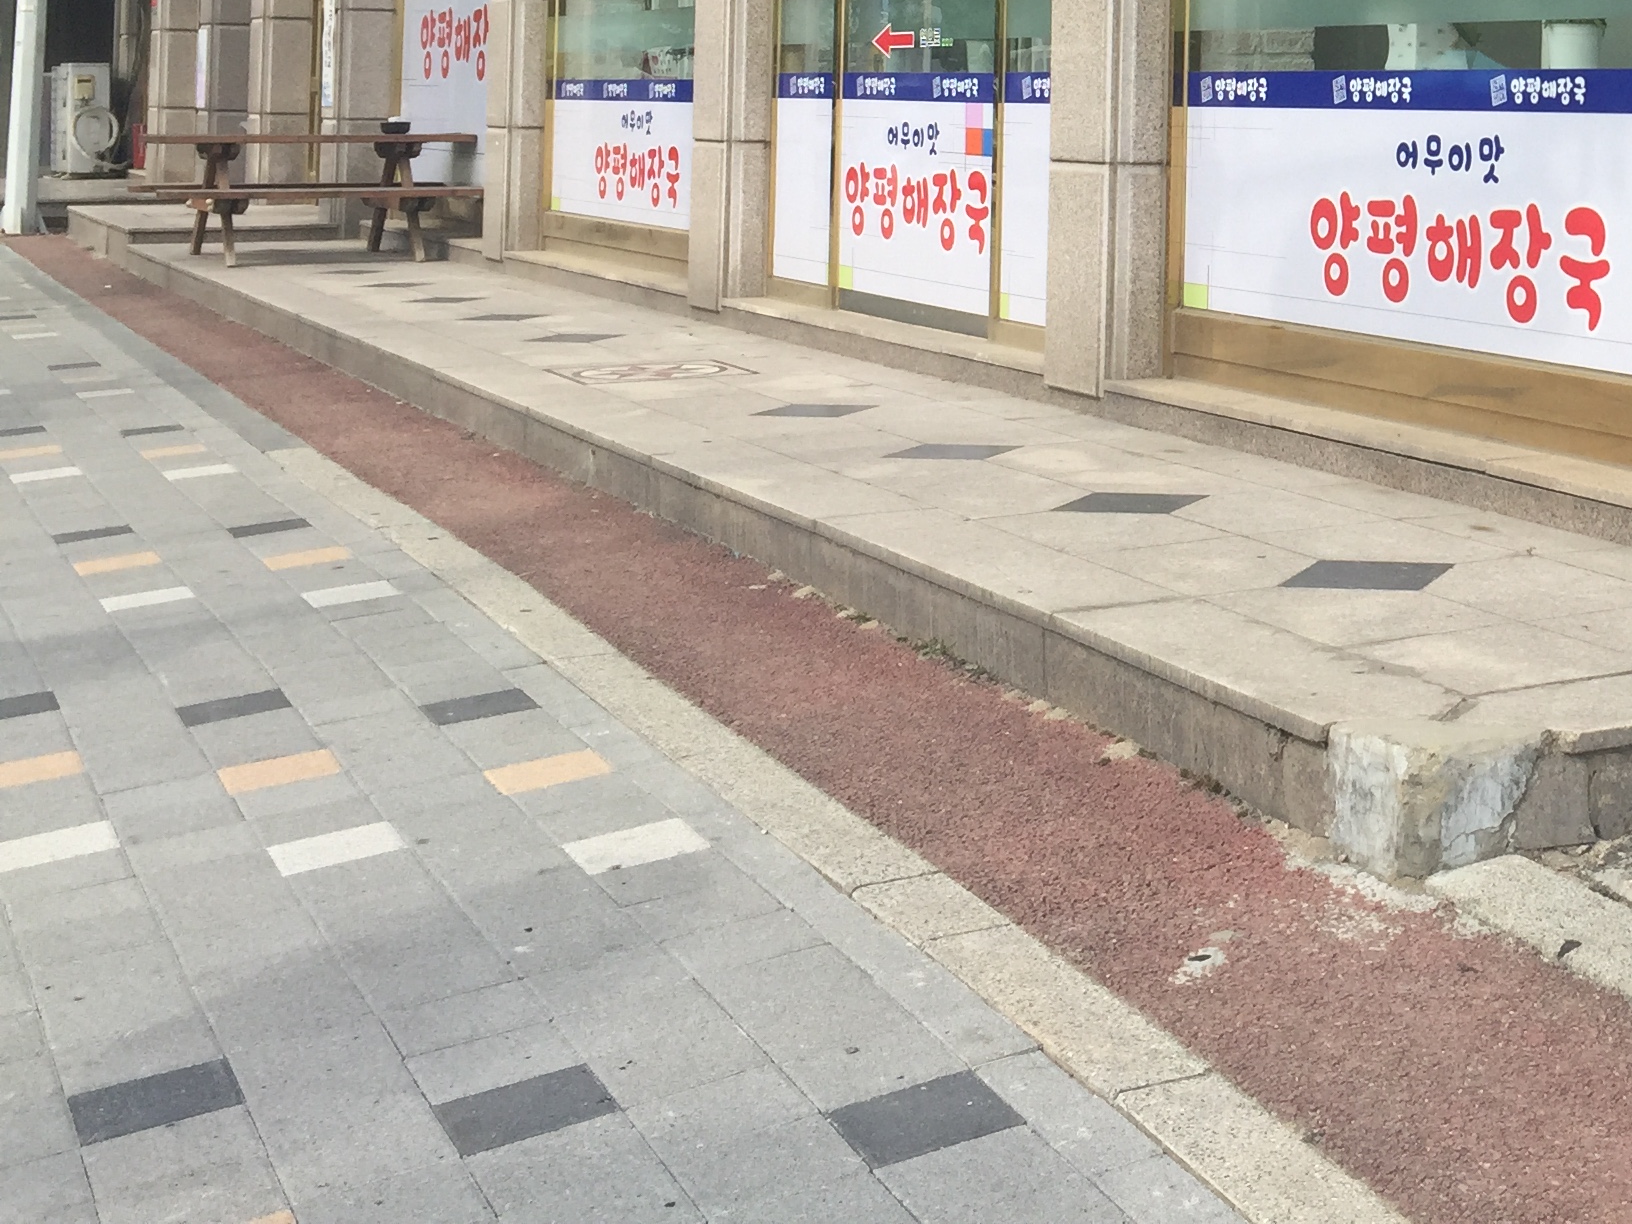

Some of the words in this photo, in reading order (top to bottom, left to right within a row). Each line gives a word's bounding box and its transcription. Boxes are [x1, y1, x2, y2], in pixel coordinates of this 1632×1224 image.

[420, 3, 489, 82] 양평해장
[1214, 76, 1268, 102] 양평해장국
[1349, 76, 1413, 104] 양평해장국
[1510, 76, 1587, 106] 양평해장국
[887, 121, 940, 156] 어무이맛
[1396, 134, 1504, 184] 어무이맛
[594, 141, 681, 209] 양평해장국
[845, 162, 990, 255] 양평해장국
[1310, 191, 1611, 332] 양평해장국
